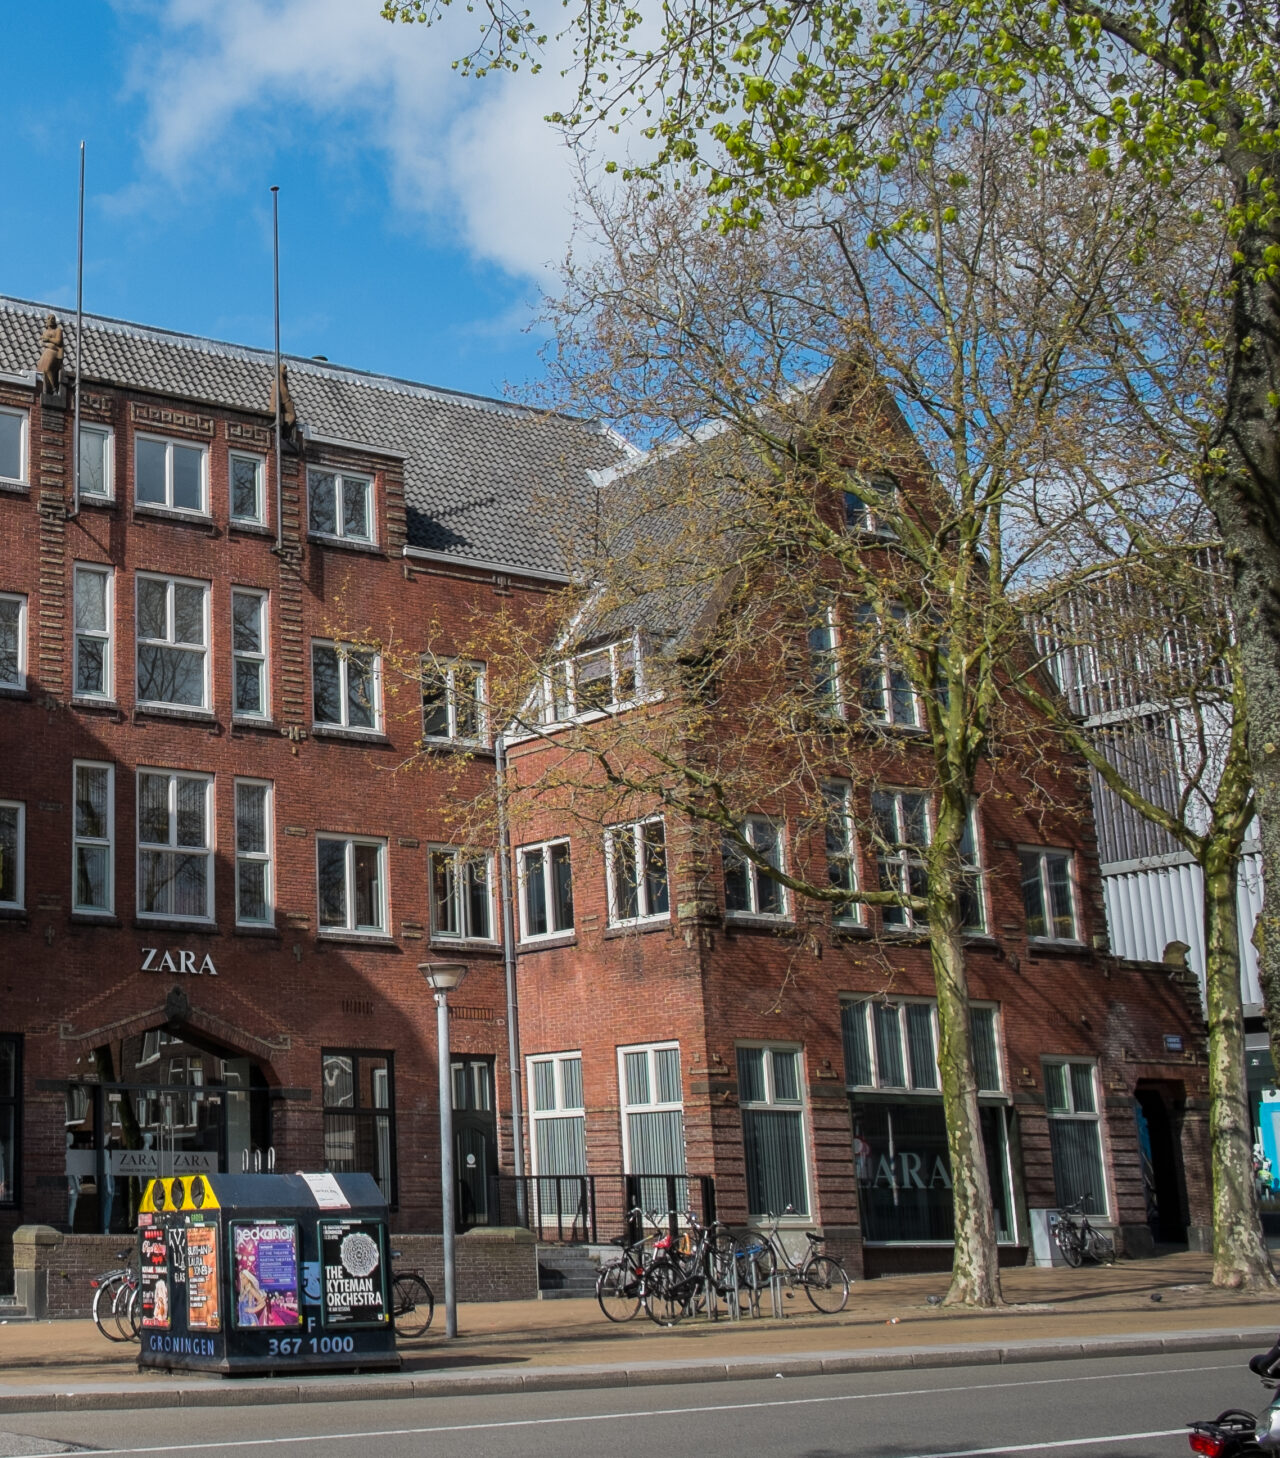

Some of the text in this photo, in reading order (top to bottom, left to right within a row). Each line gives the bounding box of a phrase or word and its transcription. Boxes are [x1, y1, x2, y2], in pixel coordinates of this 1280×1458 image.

[141, 948, 218, 975] ZARA
[120, 1153, 157, 1166] ZARA
[173, 1154, 210, 1167] ZARA
[858, 1152, 954, 1189] ARA
[174, 1272, 186, 1283] GLAS
[325, 1265, 343, 1279] THE
[326, 1278, 373, 1293] KYTEMAN
[327, 1291, 383, 1306] ORCHESTRA
[150, 1335, 215, 1356] GRONINGEN
[268, 1336, 354, 1356] 367 1000
